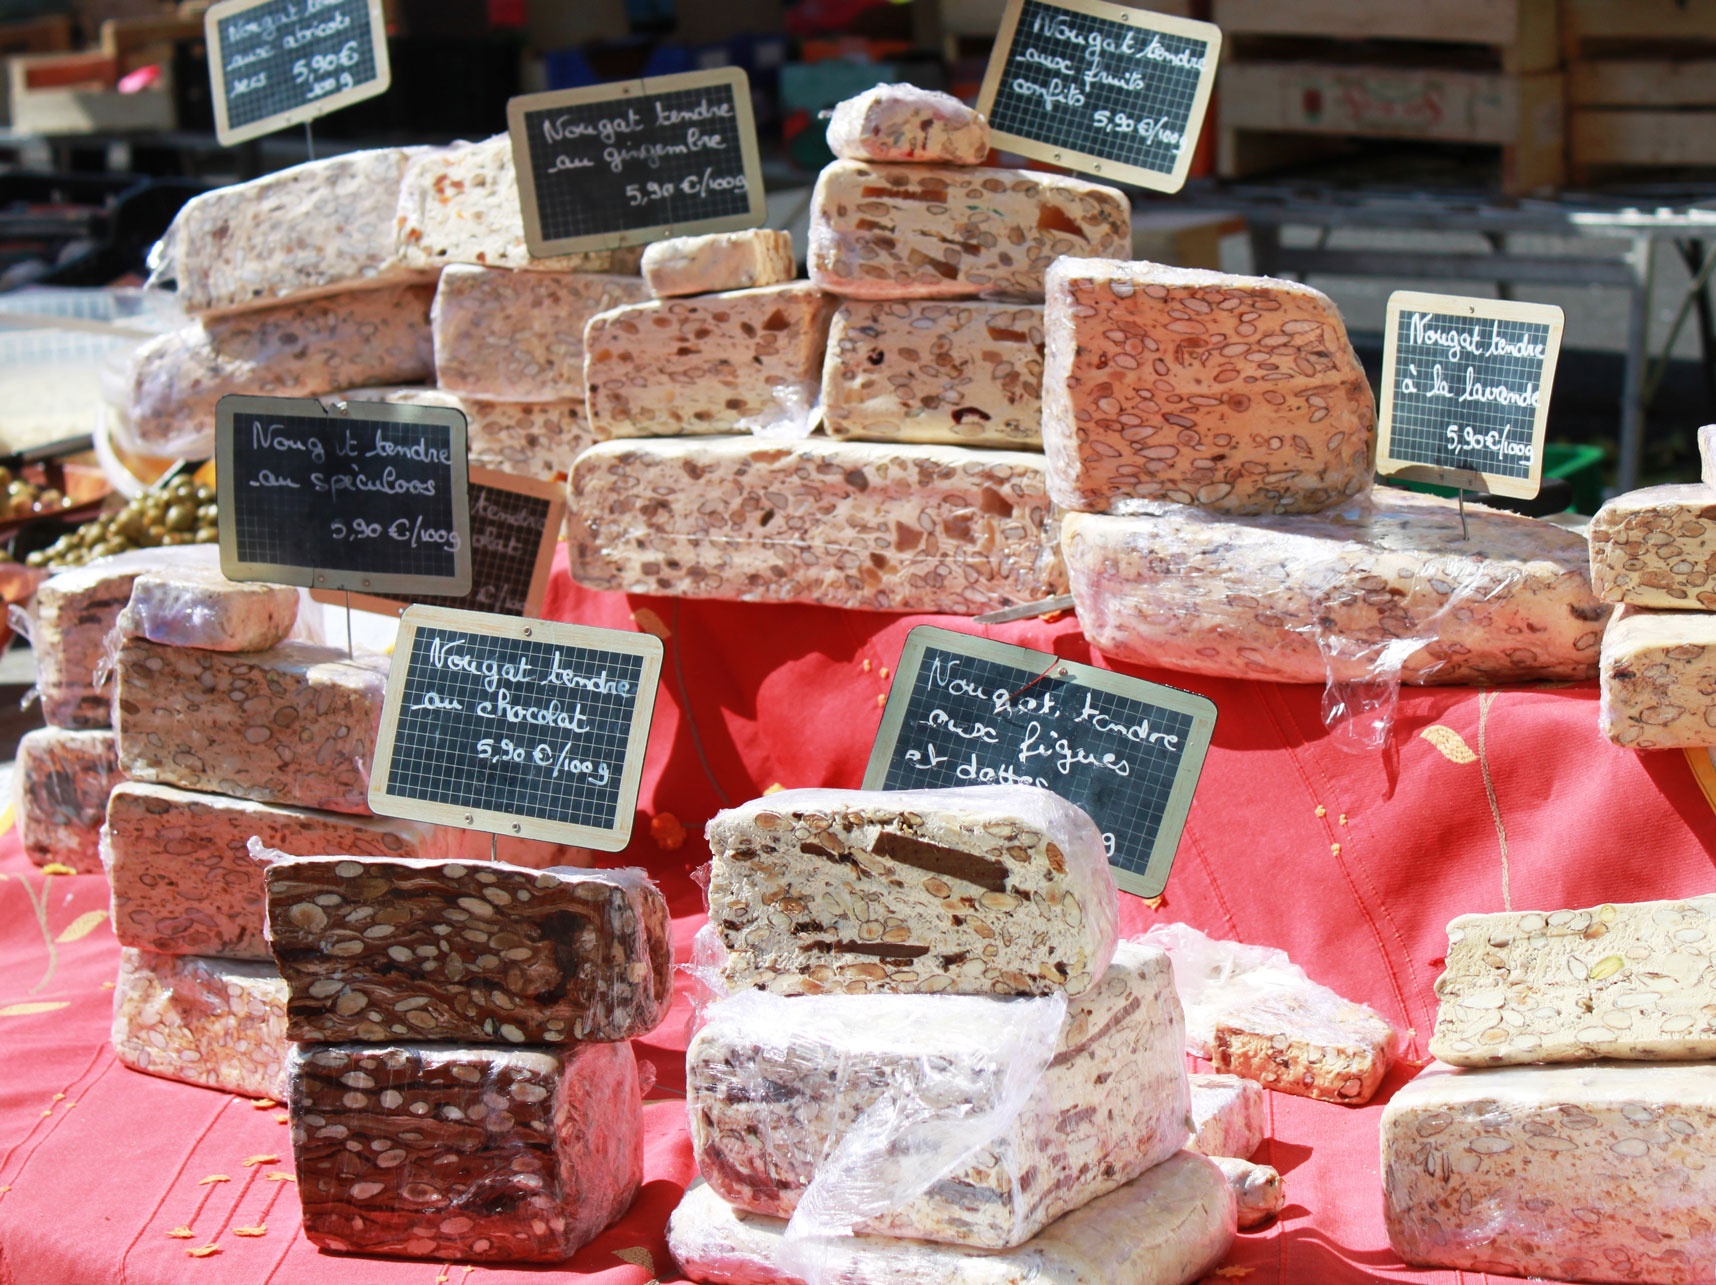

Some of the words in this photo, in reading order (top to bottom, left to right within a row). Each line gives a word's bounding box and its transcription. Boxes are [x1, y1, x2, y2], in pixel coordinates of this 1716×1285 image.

[1033, 13, 1135, 62] Nougat
[1016, 48, 1075, 75] aux
[1012, 78, 1085, 112] confits
[542, 108, 645, 145] Nougat
[655, 98, 734, 127] tendre
[547, 154, 595, 173] au
[625, 182, 675, 206] 5,90
[1409, 312, 1483, 362] Nougat
[1485, 319, 1546, 359] tendre
[1402, 364, 1417, 394] à
[1426, 363, 1454, 398] la
[1458, 366, 1541, 408] lavande
[365, 427, 452, 465] tendre
[249, 469, 301, 489] au
[429, 637, 536, 692] Nougat
[540, 650, 631, 699] tendre
[410, 691, 463, 711] au
[476, 688, 590, 734] chocolat
[1073, 692, 1179, 752] tendre
[476, 738, 526, 764] 5,90
[1018, 720, 1130, 777] figues
